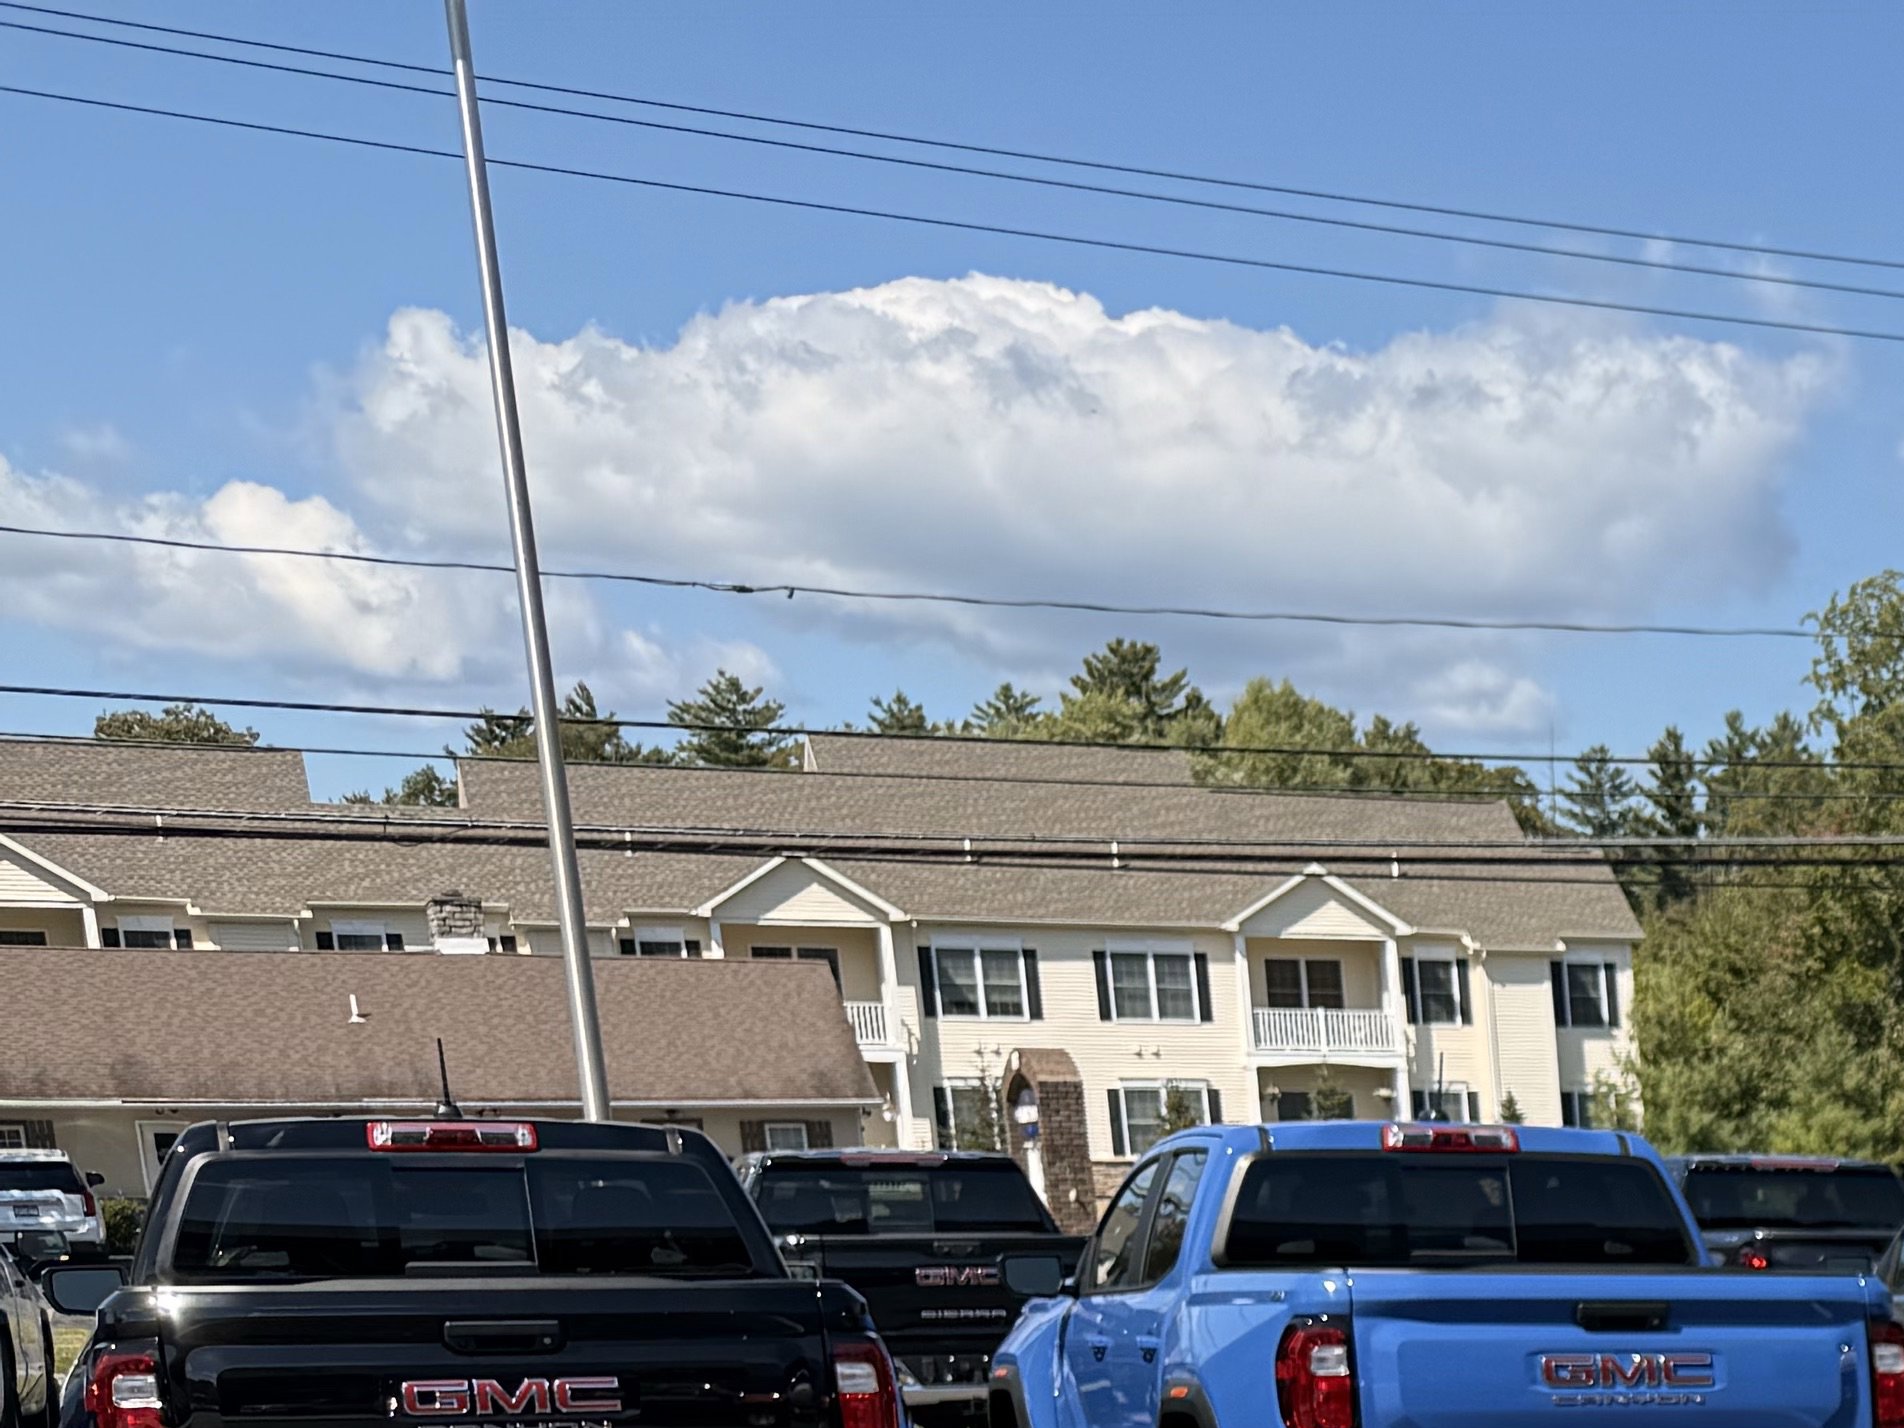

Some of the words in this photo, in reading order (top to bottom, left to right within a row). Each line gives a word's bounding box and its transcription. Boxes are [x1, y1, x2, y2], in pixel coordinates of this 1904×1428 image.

[915, 1266, 1000, 1286] GMC
[1541, 1352, 1713, 1388] GMC
[401, 1376, 622, 1415] GMC
